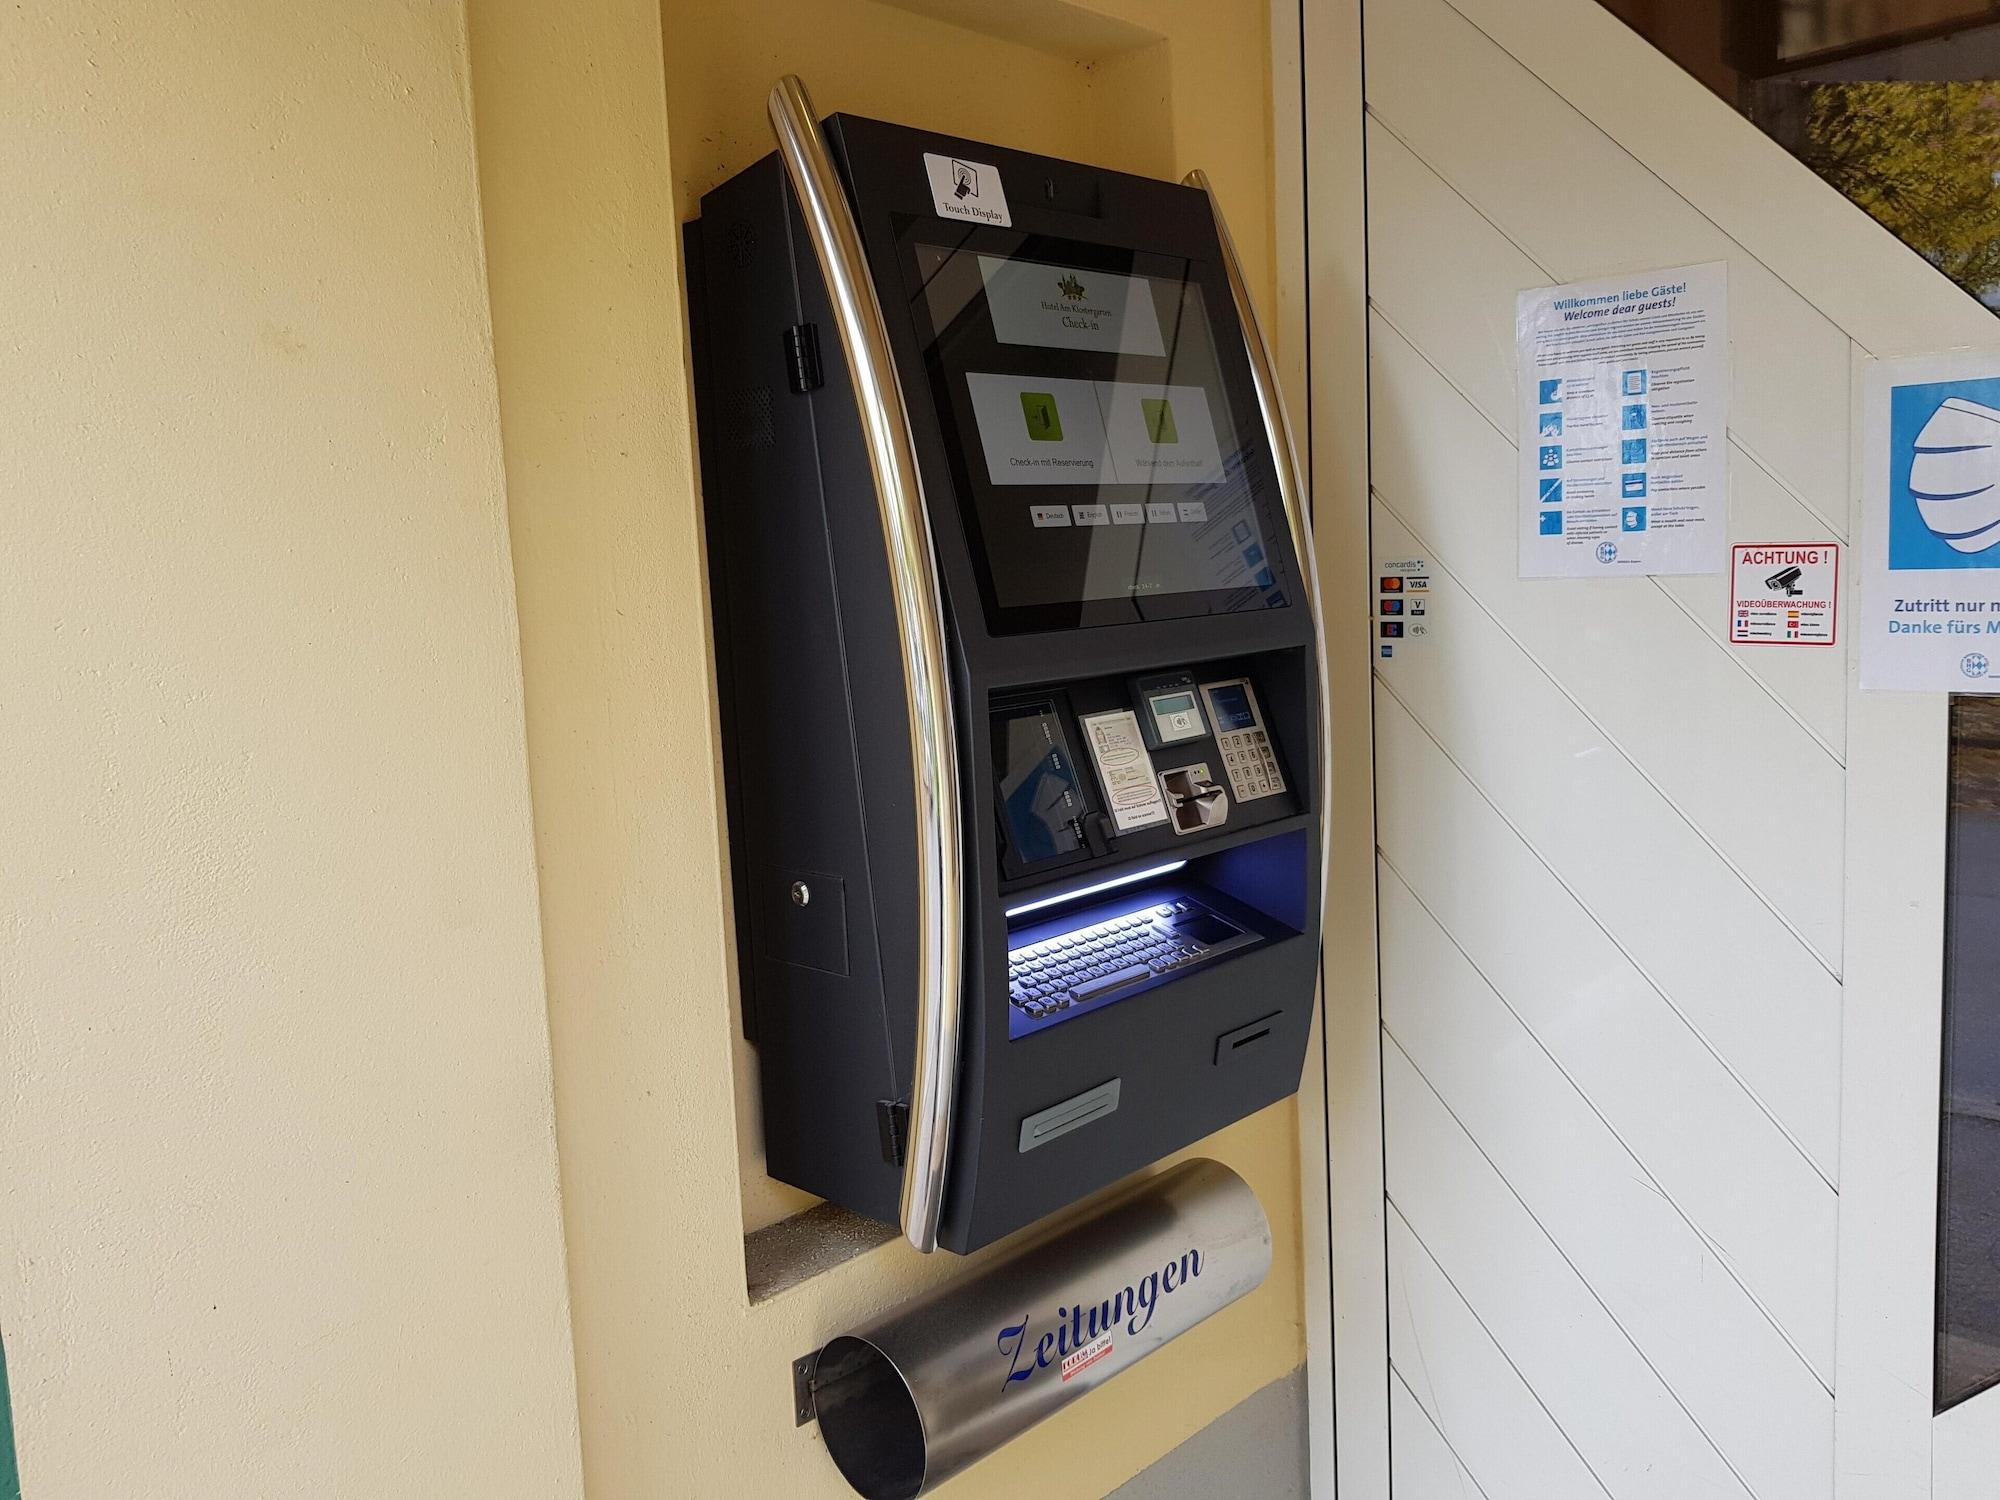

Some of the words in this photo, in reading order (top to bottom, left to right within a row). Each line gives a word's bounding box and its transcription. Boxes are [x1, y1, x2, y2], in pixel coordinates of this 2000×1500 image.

[942, 202, 970, 215] Touch
[972, 207, 1003, 223] Display
[1553, 294, 1620, 311] Willkommen
[1622, 289, 1649, 302] liebe
[1651, 282, 1687, 297] Gäste!
[1564, 307, 1610, 321] Welcome
[1612, 303, 1636, 315] dear
[1637, 297, 1676, 315] guests!
[1062, 316, 1100, 331] Check-in
[1009, 457, 1040, 467] Check-in
[1052, 457, 1095, 469] Reservierung
[1384, 560, 1416, 569] concardis
[1742, 551, 1819, 565] ACHTUNG
[1824, 550, 1828, 565] !
[1409, 581, 1428, 589] VISA
[1736, 599, 1827, 609] VIDEOÜBERWACHUNG
[1894, 598, 1950, 612] Zutritt
[1955, 602, 1985, 612] nur
[1888, 620, 1942, 634] Danke
[1947, 620, 1981, 634] fürs
[998, 1248, 1205, 1392] Zeitungen
